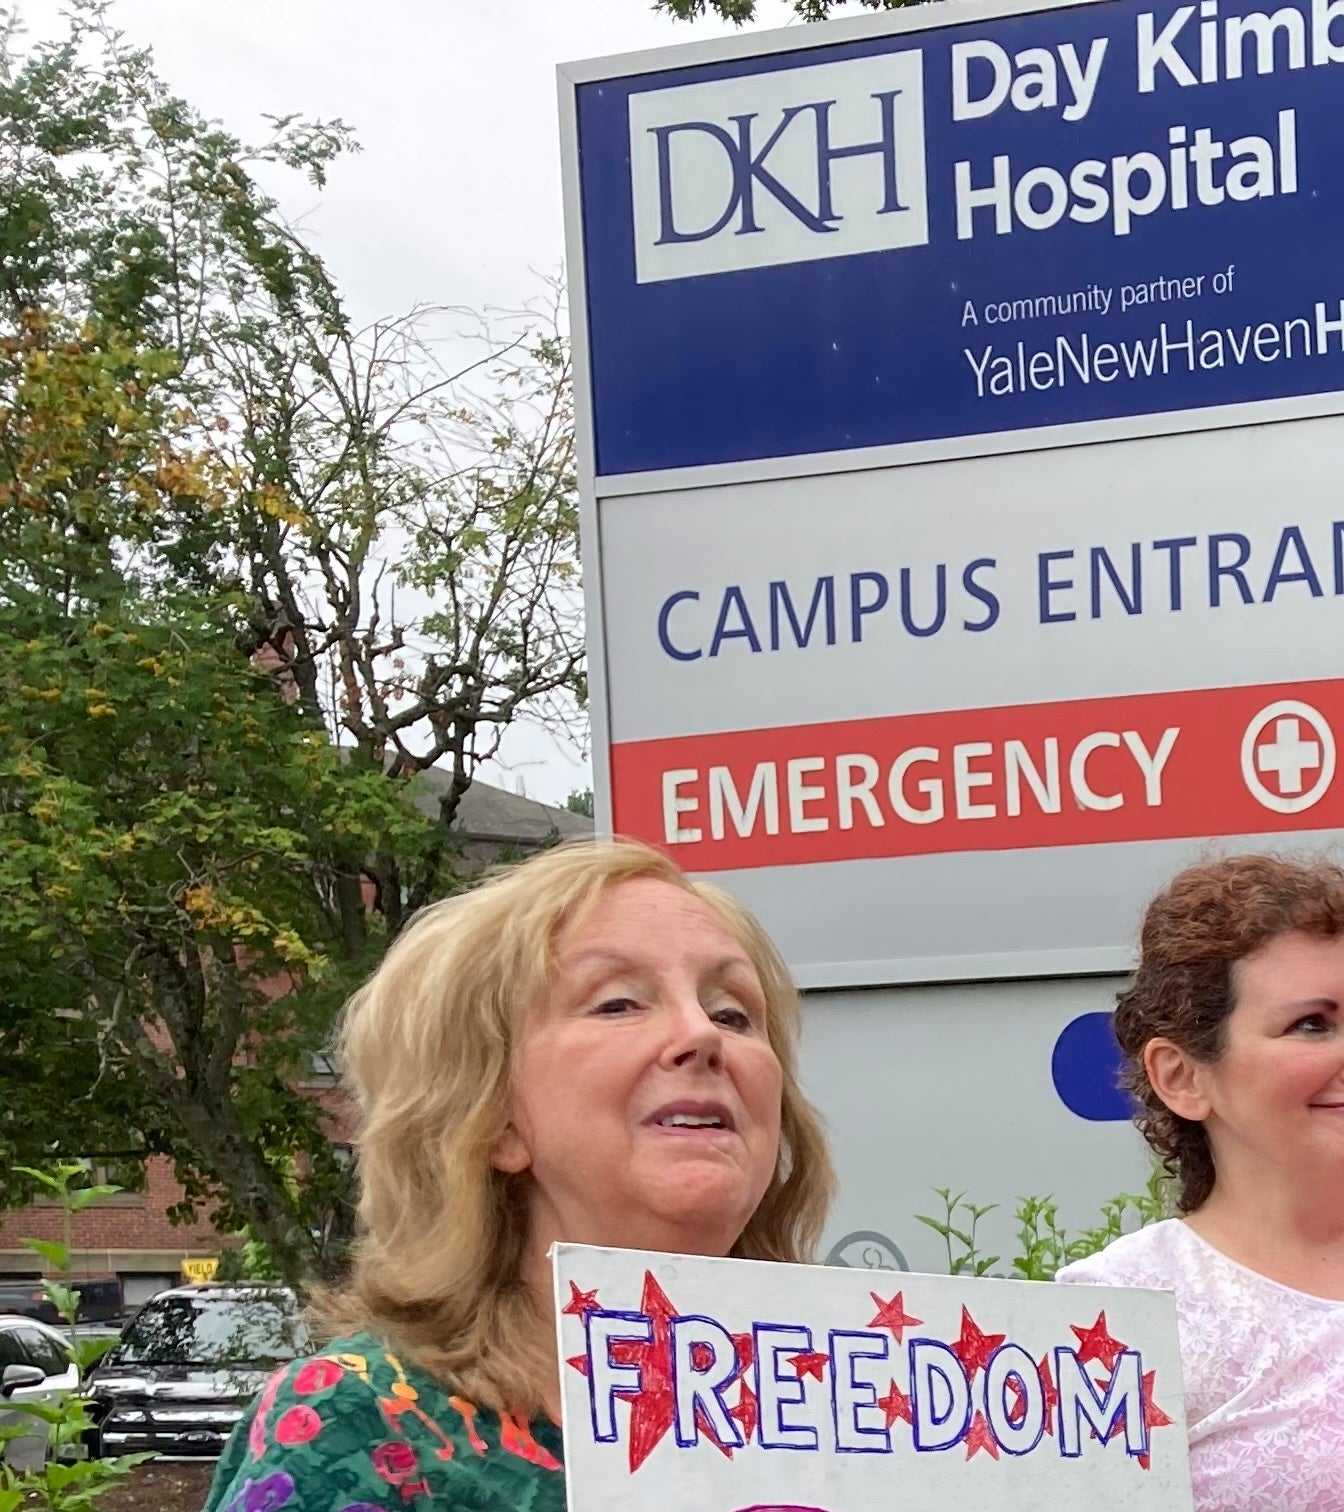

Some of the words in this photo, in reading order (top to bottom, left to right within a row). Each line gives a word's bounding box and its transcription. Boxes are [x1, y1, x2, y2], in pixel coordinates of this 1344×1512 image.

[952, 37, 1108, 122] Day
[647, 89, 911, 247] DKH
[954, 109, 1299, 240] Hospital
[961, 301, 979, 327] A
[985, 283, 1113, 326] community
[1119, 273, 1204, 311] partner
[1212, 265, 1236, 294] of
[657, 557, 1001, 662] CAMPUS
[661, 727, 1181, 846] EMERGENCY
[580, 1308, 1151, 1456] FREEDOM
